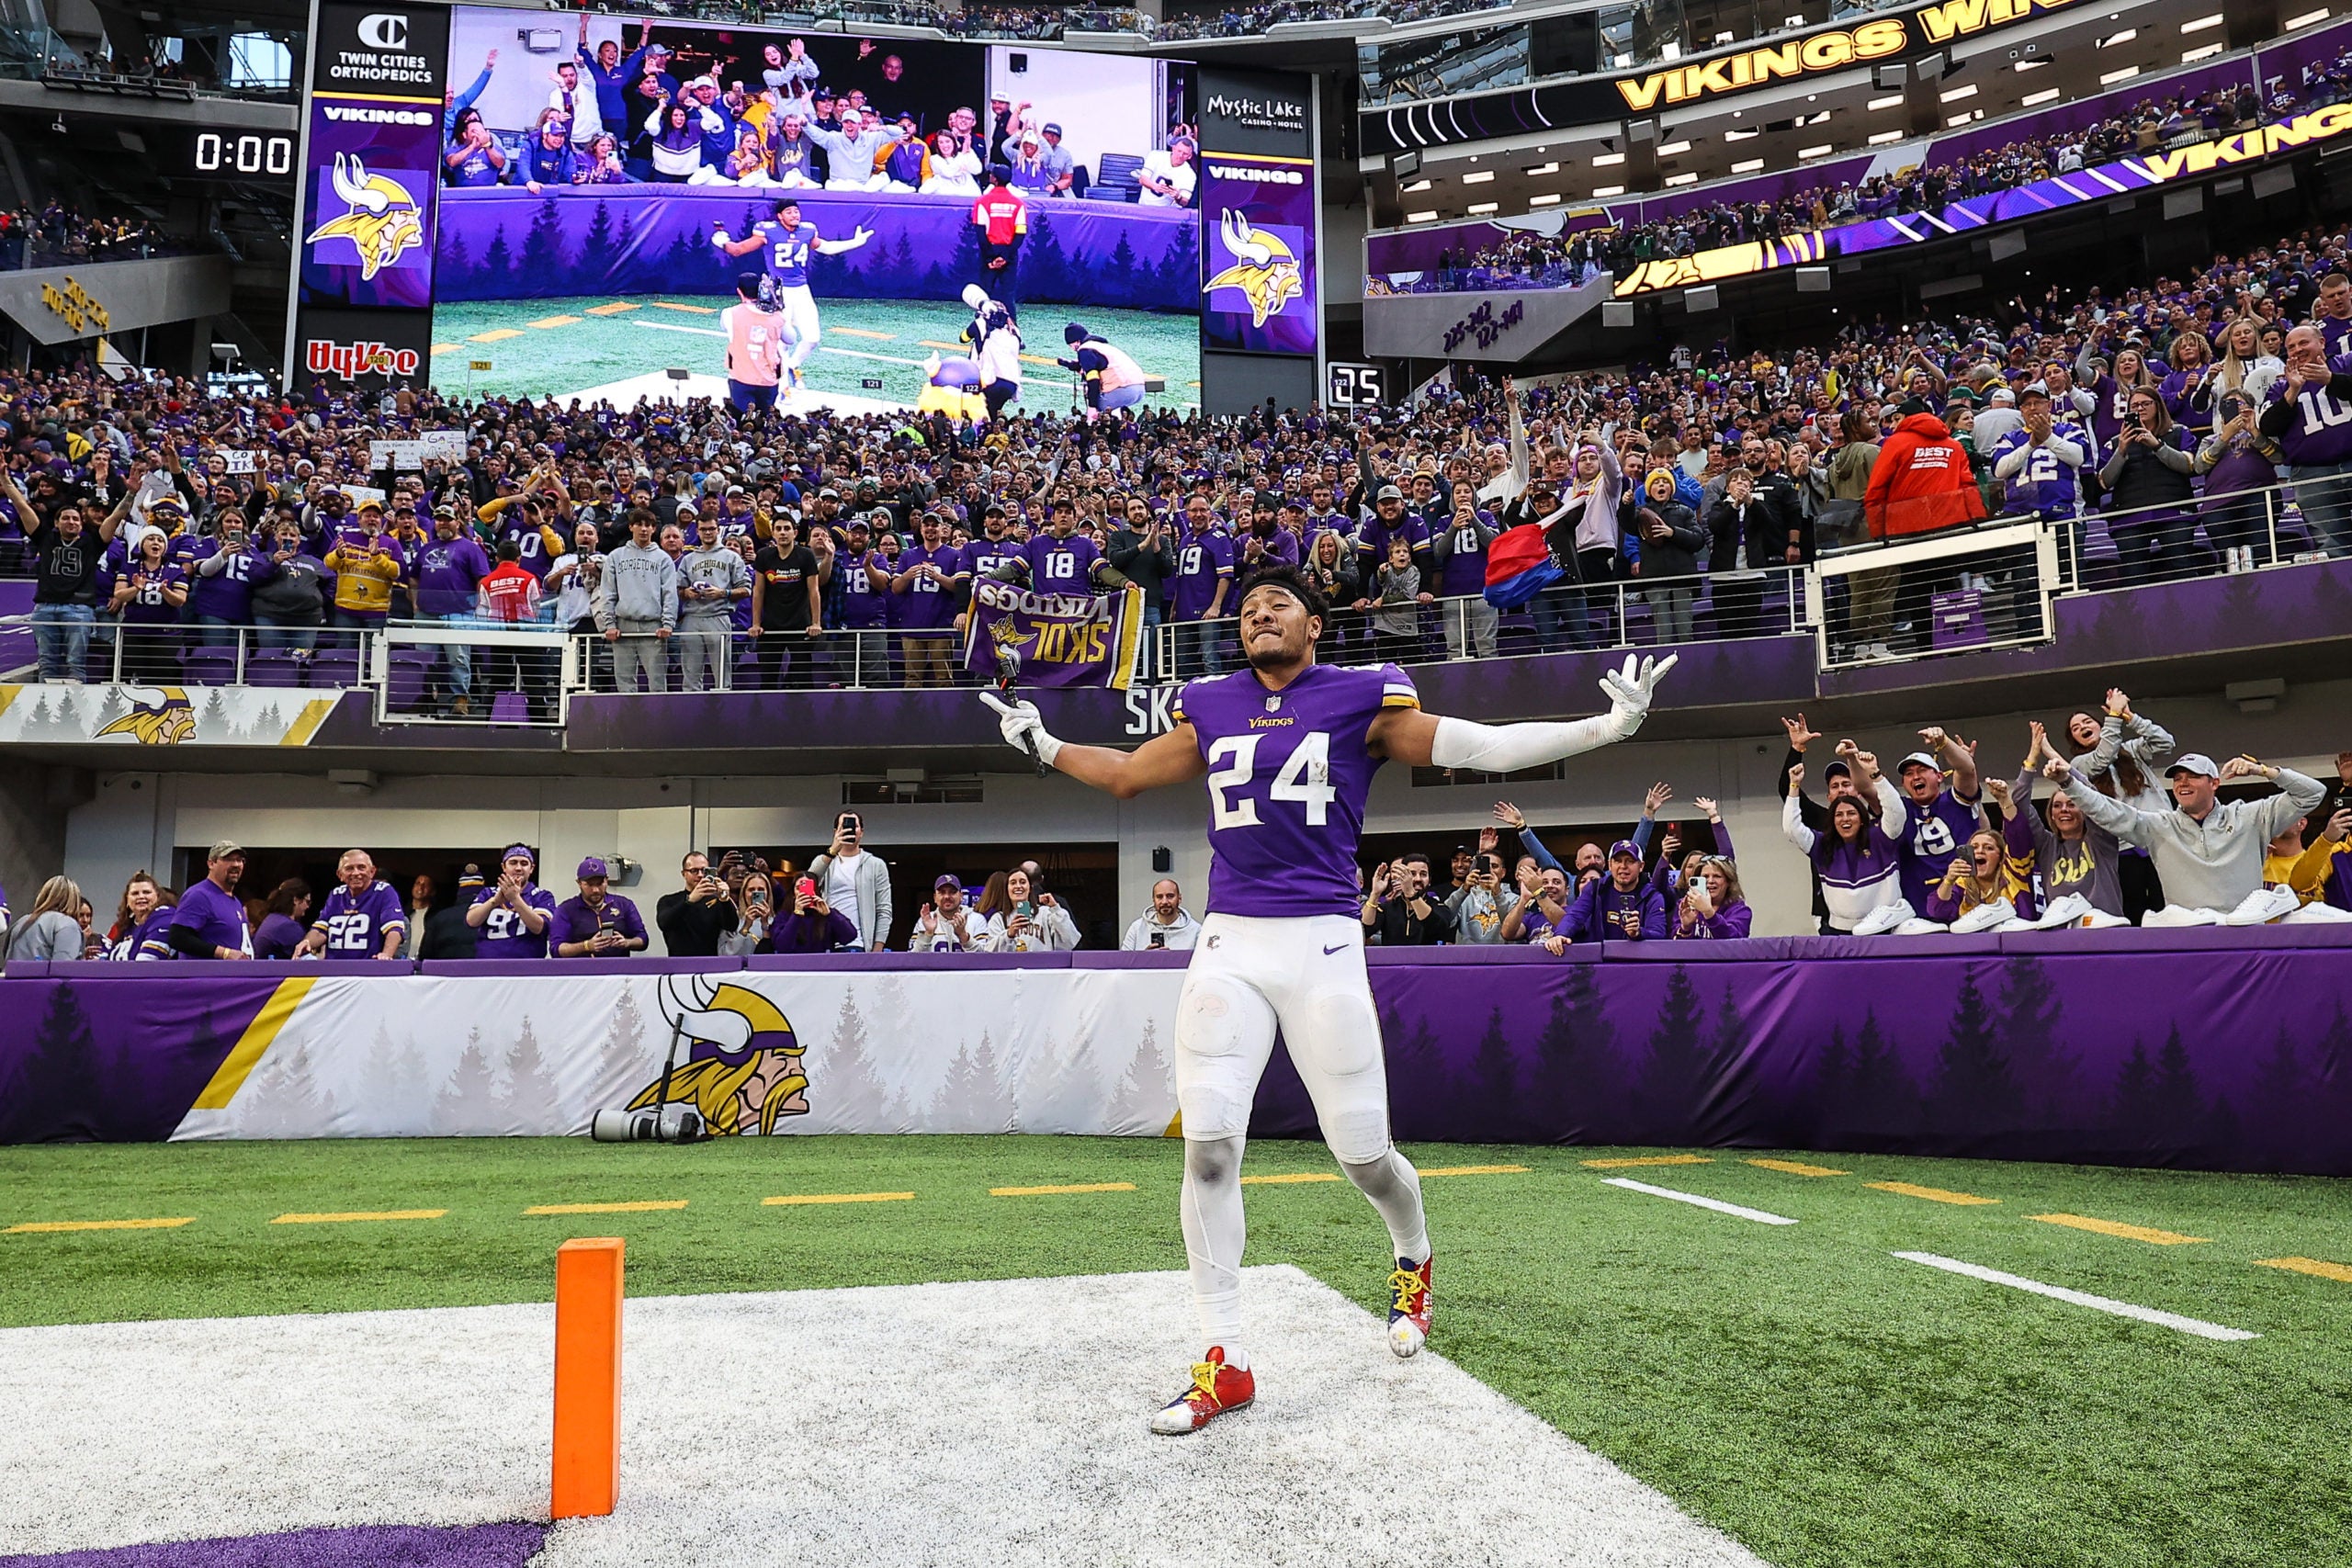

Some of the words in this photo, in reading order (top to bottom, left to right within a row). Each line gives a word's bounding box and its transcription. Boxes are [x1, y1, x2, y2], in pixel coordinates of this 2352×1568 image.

[339, 51, 378, 65] TWIN
[380, 54, 426, 69] CITIES
[1615, 18, 1908, 112] VIKINGS
[330, 65, 433, 83] ORTHOPEDICS
[2274, 94, 2290, 107] 22
[323, 106, 434, 127] VIKINGS
[1241, 118, 1272, 126] CASINO
[1278, 120, 1304, 130] HOTEL
[196, 133, 291, 175] 0:00
[1208, 164, 1304, 185] VIKINGS
[775, 243, 808, 267] 24
[369, 355, 385, 364] 120
[474, 361, 489, 369] 121
[865, 379, 879, 388] 121
[966, 383, 979, 392] 122
[1333, 378, 1348, 387] 122
[1914, 446, 1954, 458] BEST
[2015, 446, 2059, 488] 12
[507, 529, 543, 558] 10
[1453, 528, 1478, 555] 18
[50, 546, 83, 578] 19
[617, 558, 660, 575] GEORGETOWN
[691, 559, 726, 574] MICHIGAN
[1045, 552, 1075, 579] 18
[1179, 546, 1203, 576] 19
[490, 577, 526, 589] BEST
[703, 569, 713, 577] M
[1030, 619, 1111, 665] SKOL
[1125, 687, 1176, 735] SK
[1207, 731, 1337, 831] 24
[1914, 816, 1956, 856] 19
[327, 913, 370, 950] 22
[486, 907, 526, 941] 97
